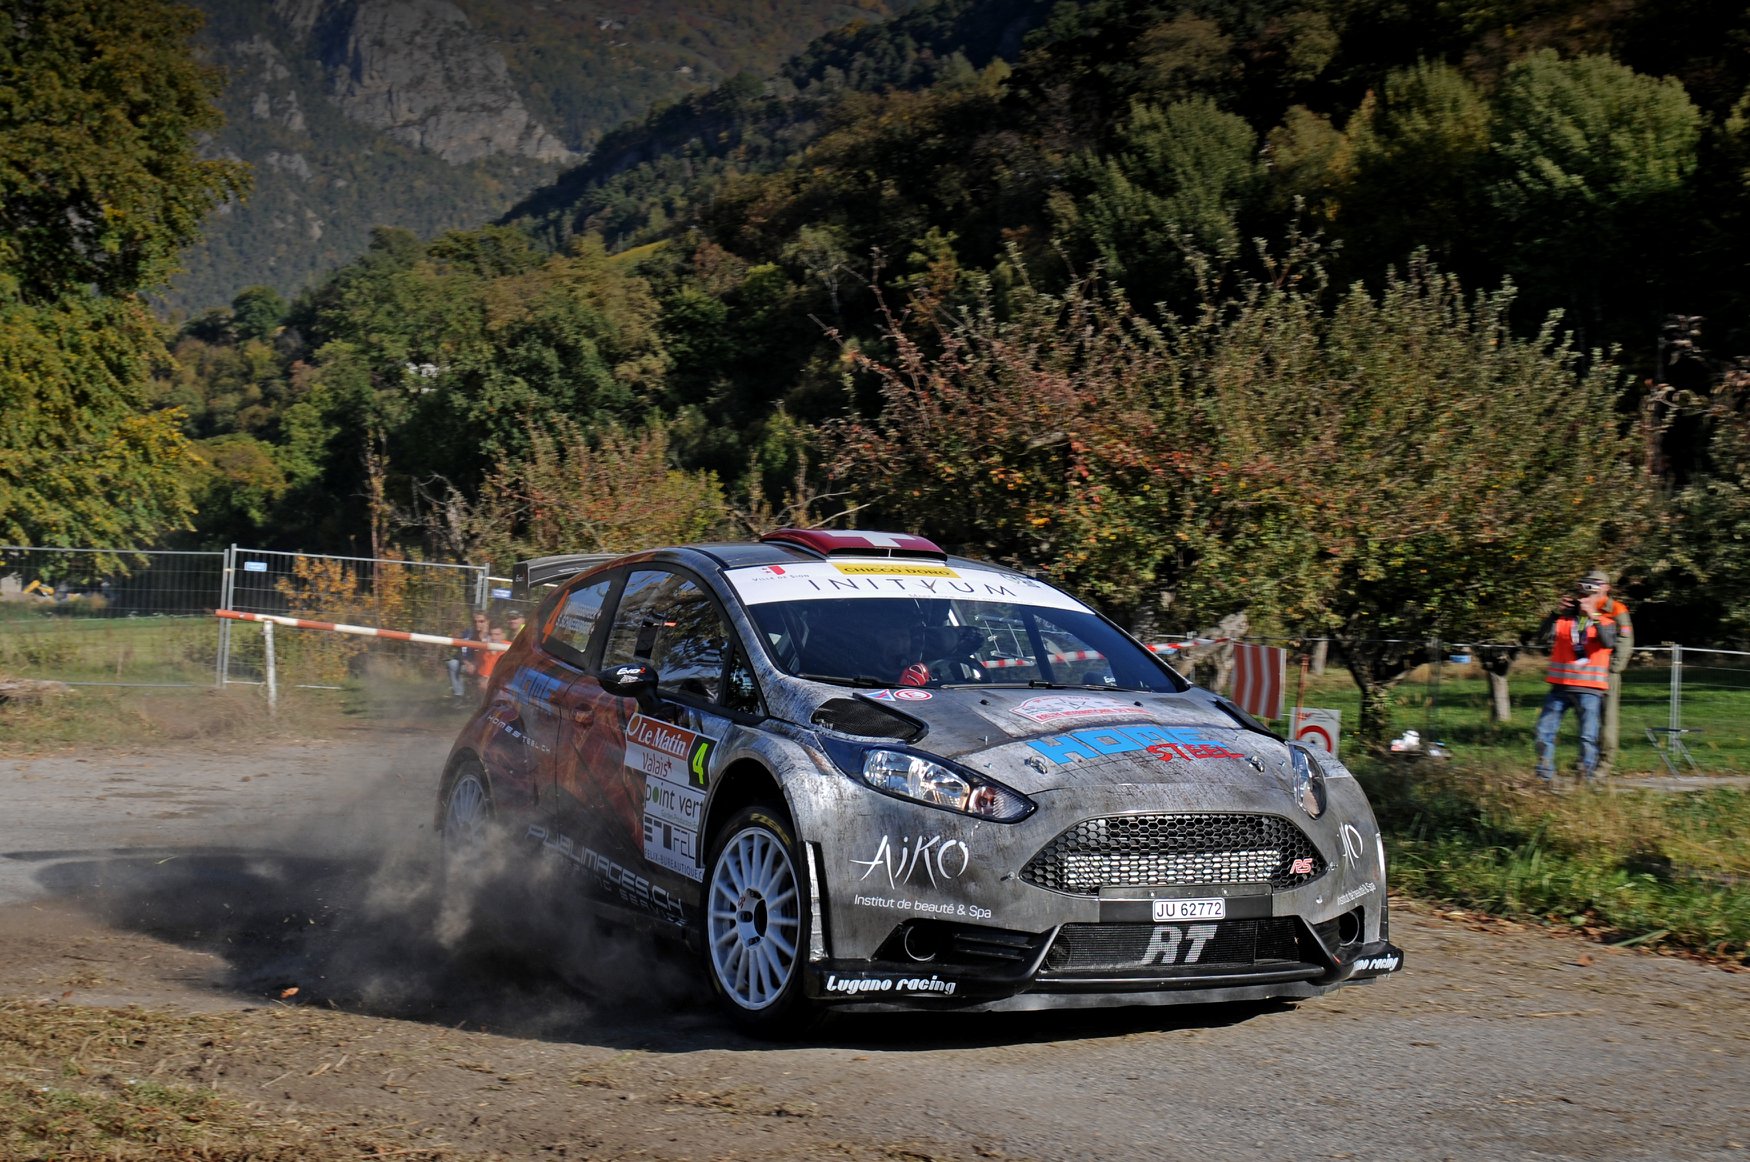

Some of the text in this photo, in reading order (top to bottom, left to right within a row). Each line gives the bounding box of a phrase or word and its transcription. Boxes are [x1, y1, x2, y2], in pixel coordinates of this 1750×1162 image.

[637, 723, 687, 757] Le Matin
[642, 752, 669, 777] Valais
[692, 742, 709, 785] 4
[644, 782, 676, 811] point
[1290, 858, 1314, 875] RS
[854, 894, 992, 921] Institut de beauté & Spa
[1156, 901, 1222, 917] JU 62772
[826, 975, 956, 995] Lugano racing
